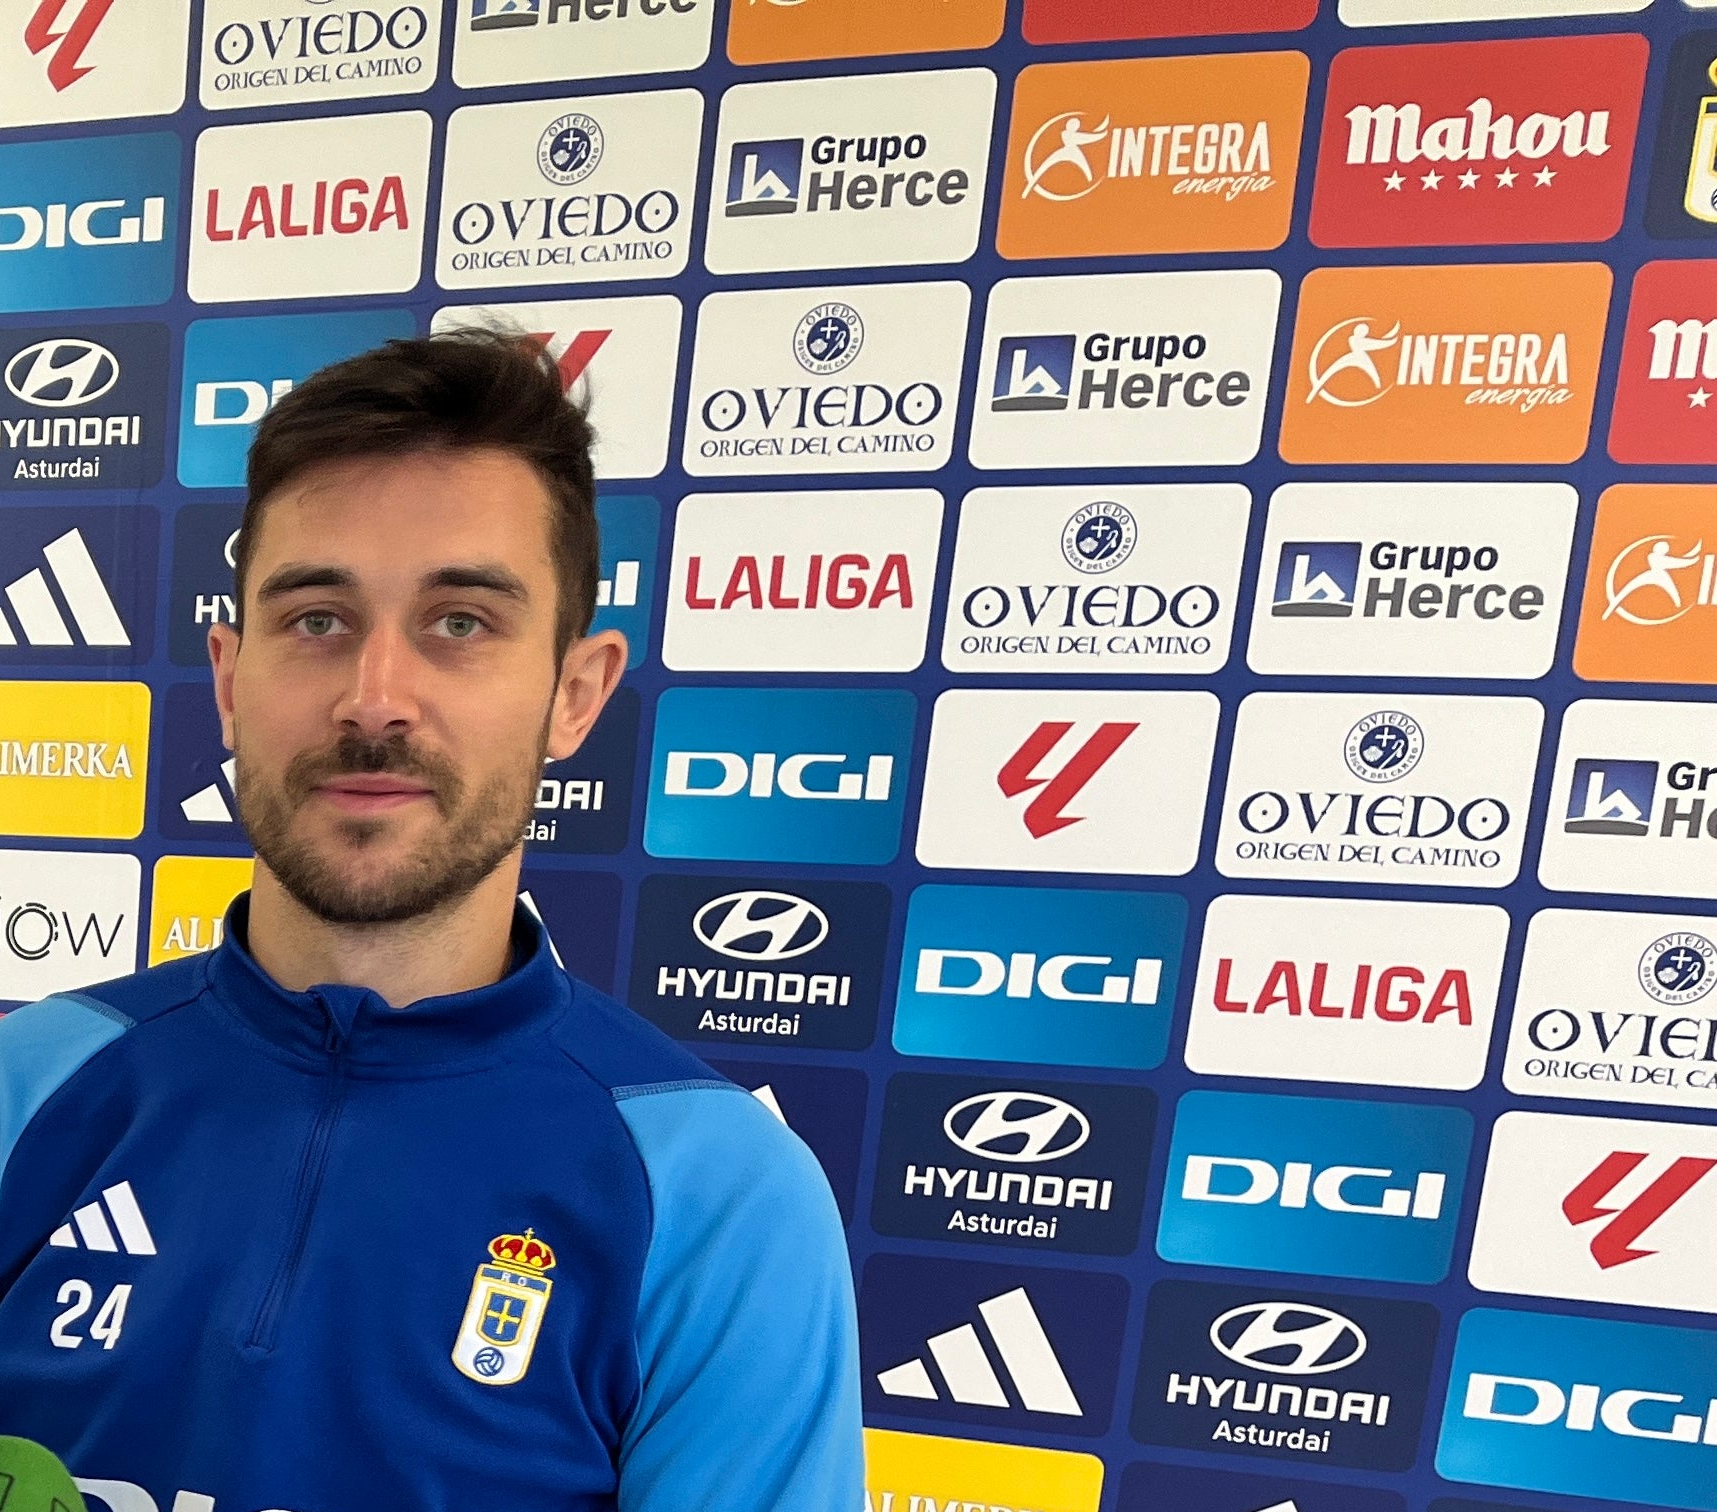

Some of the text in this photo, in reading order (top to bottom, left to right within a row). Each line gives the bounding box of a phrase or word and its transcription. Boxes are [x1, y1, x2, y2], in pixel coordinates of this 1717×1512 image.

[214, 7, 427, 65] OVIEDO
[214, 56, 422, 92] ORIGEN DEL CAMINO
[810, 132, 927, 168] Grupo
[1108, 121, 1271, 178] INTEGRA
[206, 176, 408, 242] LALIGA
[807, 167, 969, 213] Herce
[452, 190, 679, 246] OVIEDO
[451, 241, 673, 271] ORIGEN DEL CAMINO
[1083, 332, 1206, 364] Grupo
[1397, 332, 1569, 388] INTEGRA
[701, 382, 942, 432] OVIEDO
[1077, 367, 1250, 411] Herce
[13, 457, 100, 479] Asturdai
[700, 433, 935, 459] ORIGEN DEL CAMINO
[685, 554, 913, 610] LALIGA
[1369, 541, 1499, 578] Grupo
[962, 584, 1220, 629] OVIEDO
[1362, 576, 1545, 621] Herce
[960, 635, 1211, 657] ORIGEN DEL CAMINO
[664, 751, 893, 801] DIGI
[1238, 791, 1510, 841] OVIEDO
[1235, 841, 1501, 869] ORIGEN DEL CAMINO
[657, 966, 851, 1007] HYUNDAI
[914, 948, 1162, 1005] DIGI
[1212, 957, 1472, 1026] LALIGA
[698, 1009, 800, 1036] Asturdai
[1528, 1009, 1717, 1062] OVIE
[1525, 1059, 1623, 1081] ORIGEN
[1630, 1066, 1679, 1089] DEL
[904, 1165, 1113, 1211] HYUNDAI
[1182, 1155, 1446, 1220] DIGI
[947, 1209, 1058, 1239] Asturdai
[49, 1278, 133, 1350] 24
[1167, 1372, 1390, 1426] HYUNDAI
[1211, 1419, 1330, 1453] Asturdai
